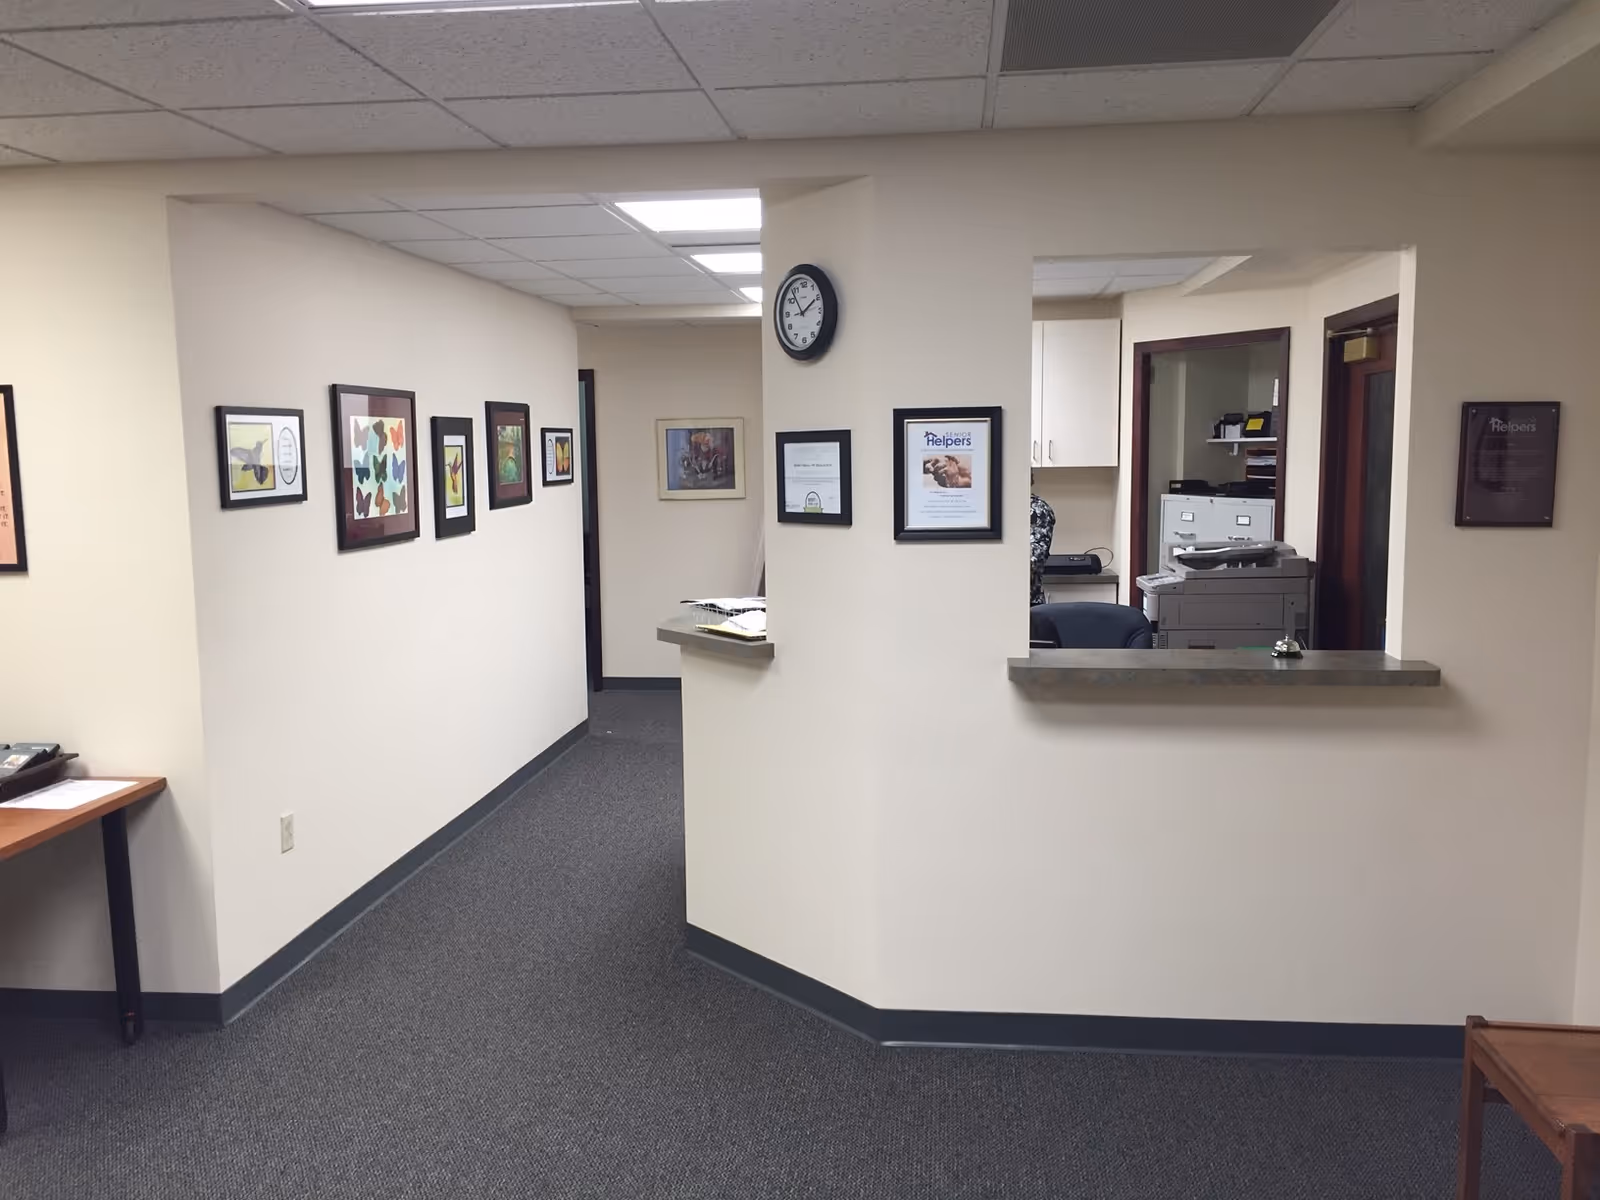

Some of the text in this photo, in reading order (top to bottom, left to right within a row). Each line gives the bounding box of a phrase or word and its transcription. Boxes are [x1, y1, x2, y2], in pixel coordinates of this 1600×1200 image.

[788, 297, 795, 305] 10
[1492, 421, 1537, 433] Helpers
[926, 435, 971, 448] Helpers
